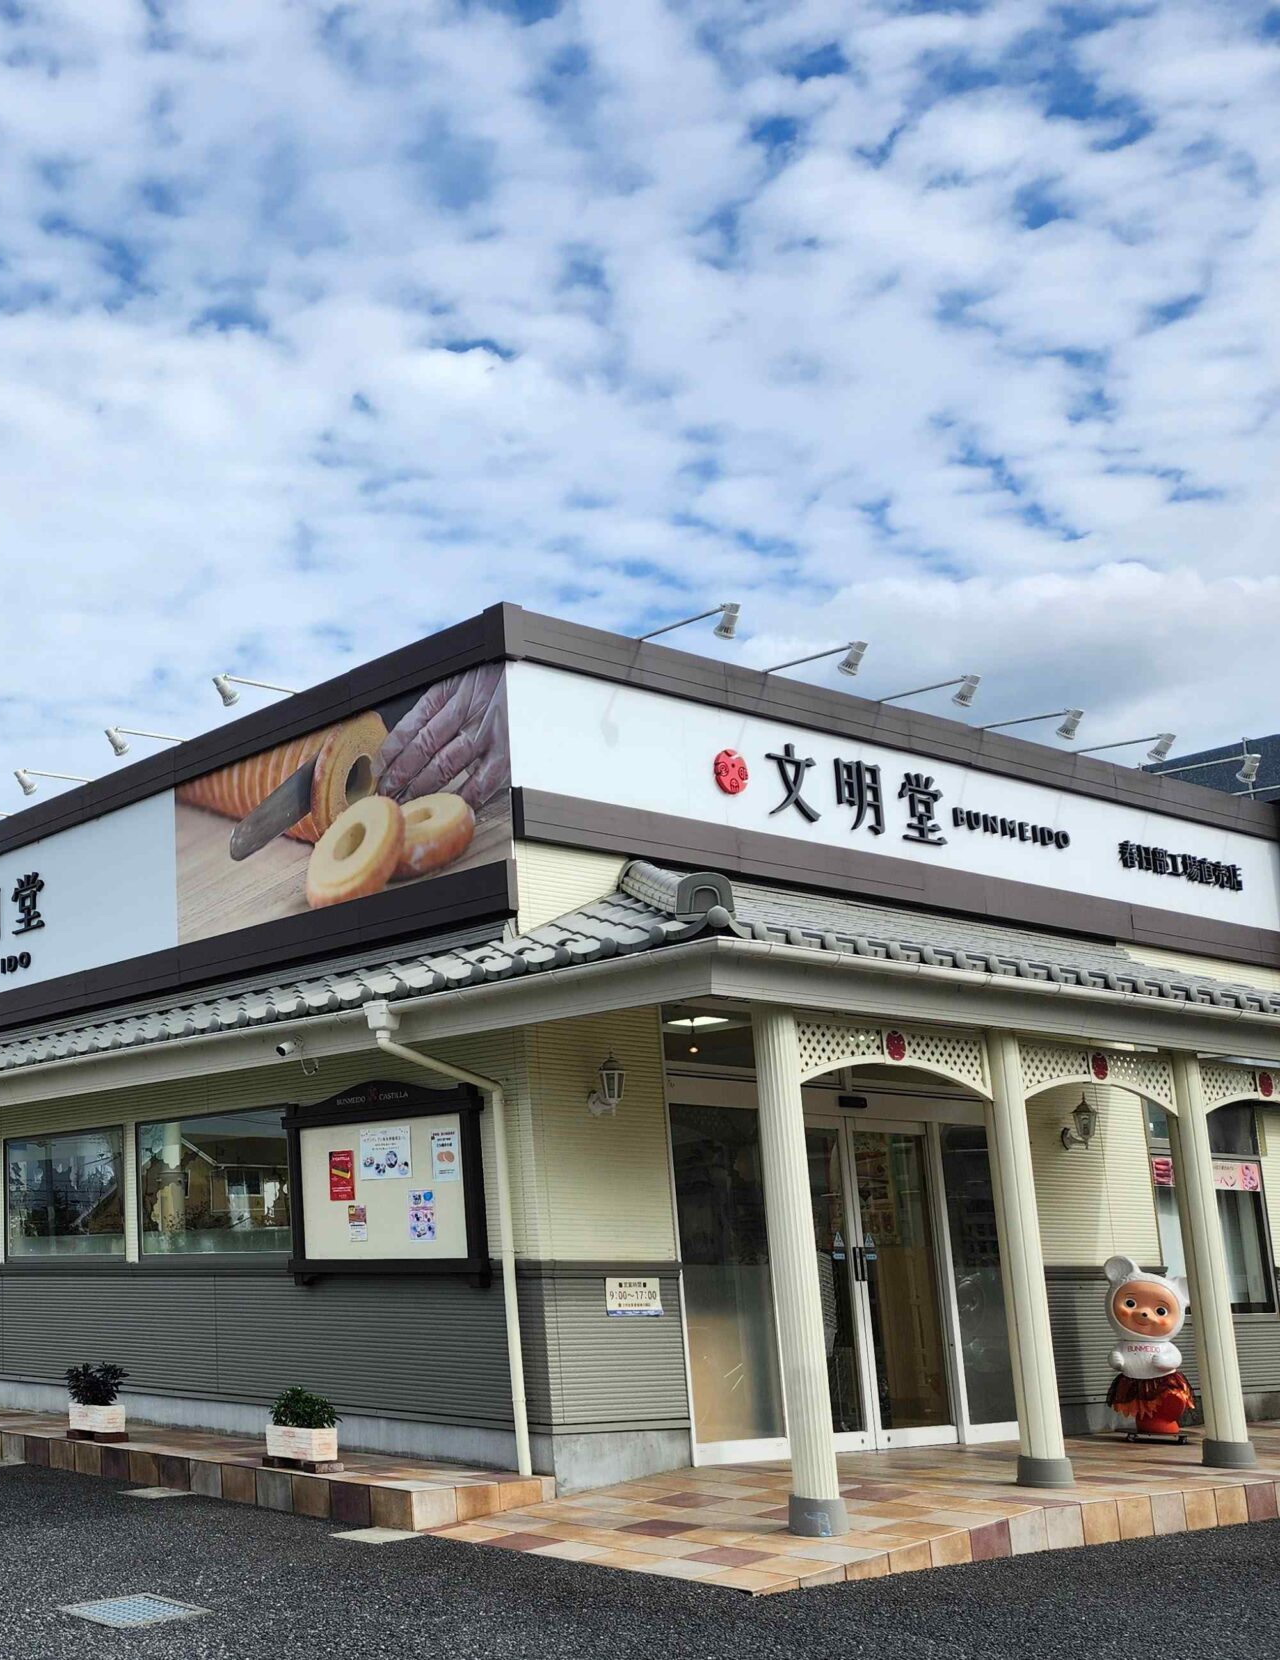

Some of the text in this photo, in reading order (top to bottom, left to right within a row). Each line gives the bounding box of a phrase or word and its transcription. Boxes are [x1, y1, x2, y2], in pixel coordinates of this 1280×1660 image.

[764, 743, 949, 847] 文明堂
[951, 806, 1071, 850] BUNMEIDO
